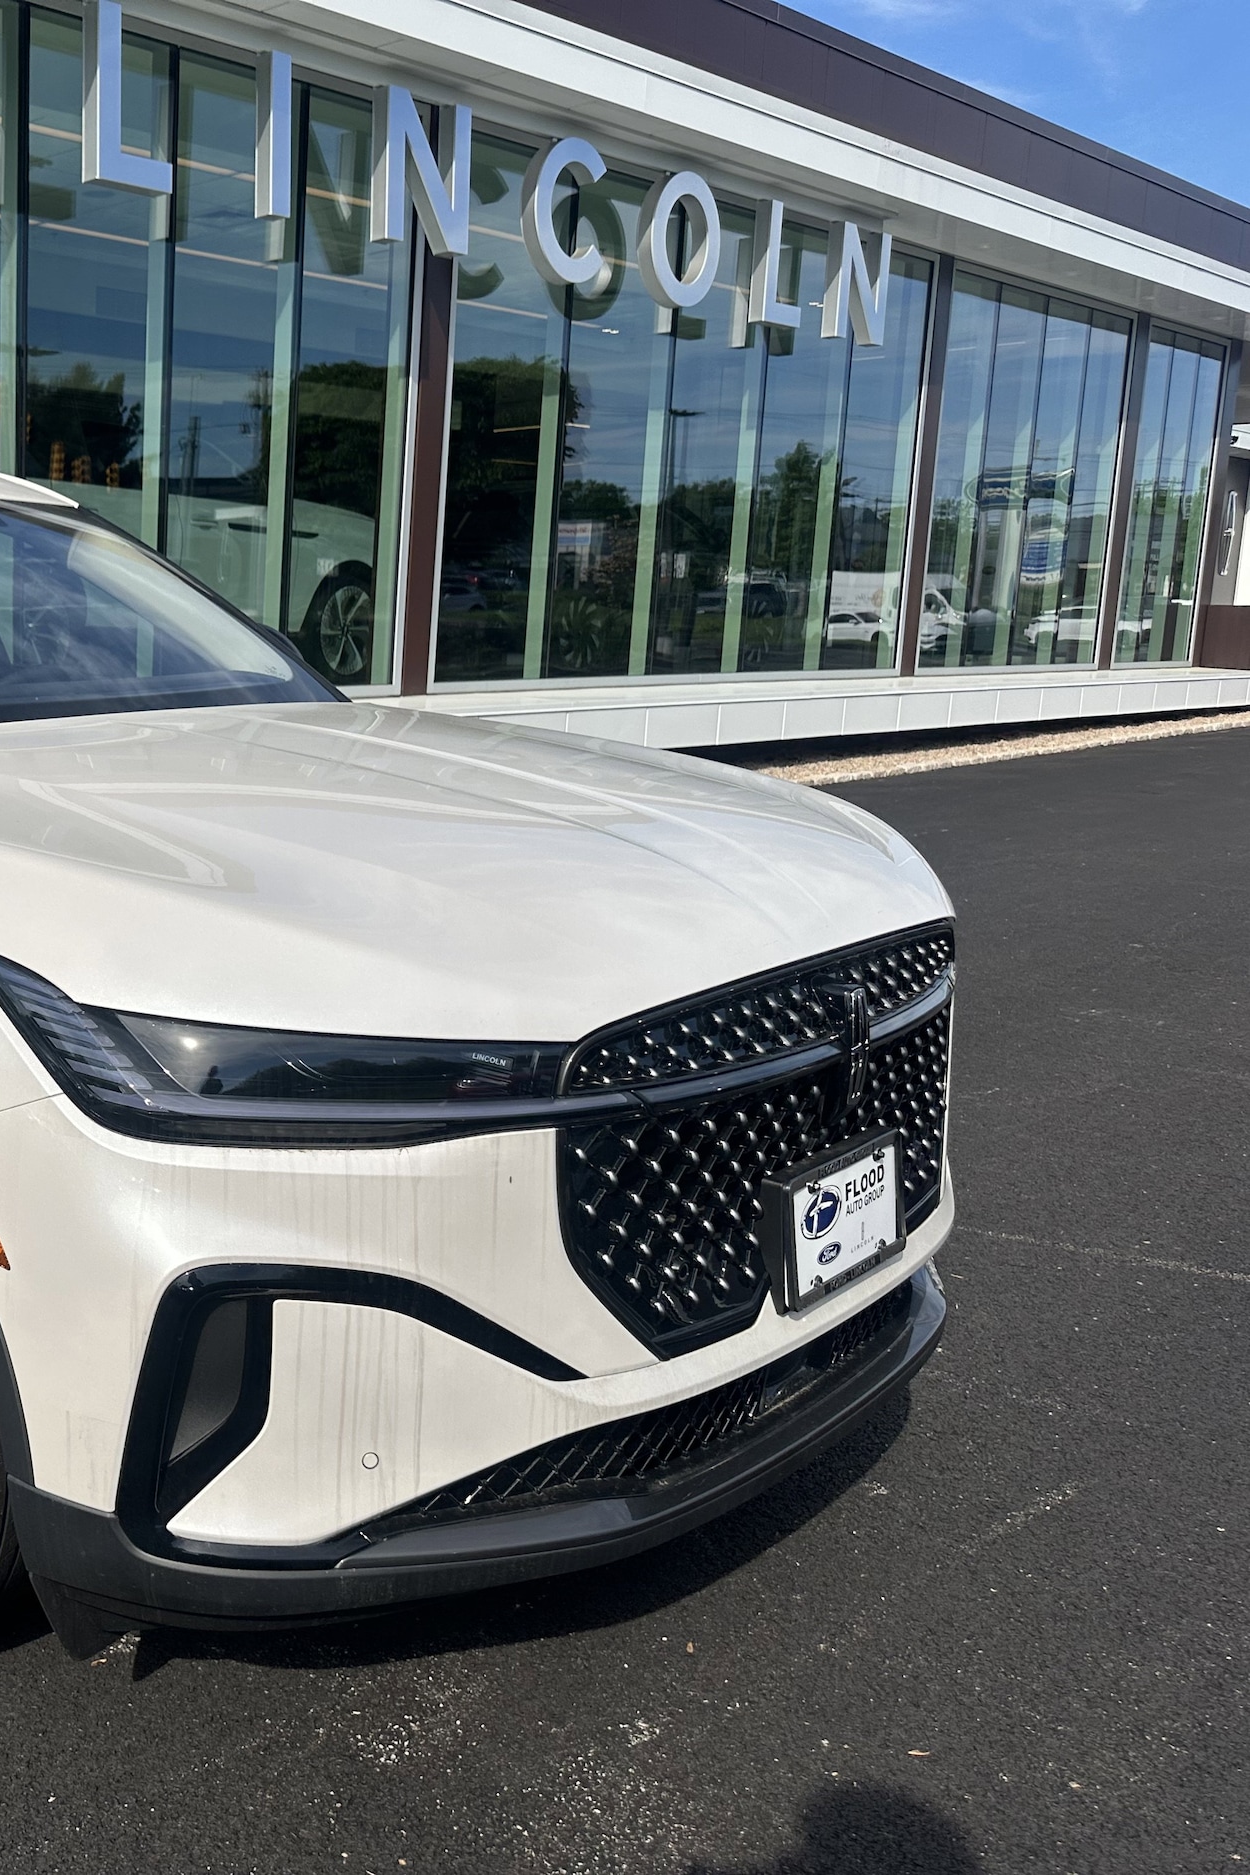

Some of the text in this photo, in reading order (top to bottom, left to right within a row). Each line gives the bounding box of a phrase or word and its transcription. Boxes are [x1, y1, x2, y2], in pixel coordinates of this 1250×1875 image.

[81, 0, 893, 348] LINCOLN
[472, 1052, 507, 1067] LINCOLN
[845, 1164, 885, 1201] FLOOD
[845, 1186, 885, 1217] AUTO GROUP
[851, 1235, 874, 1253] LINCOLN
